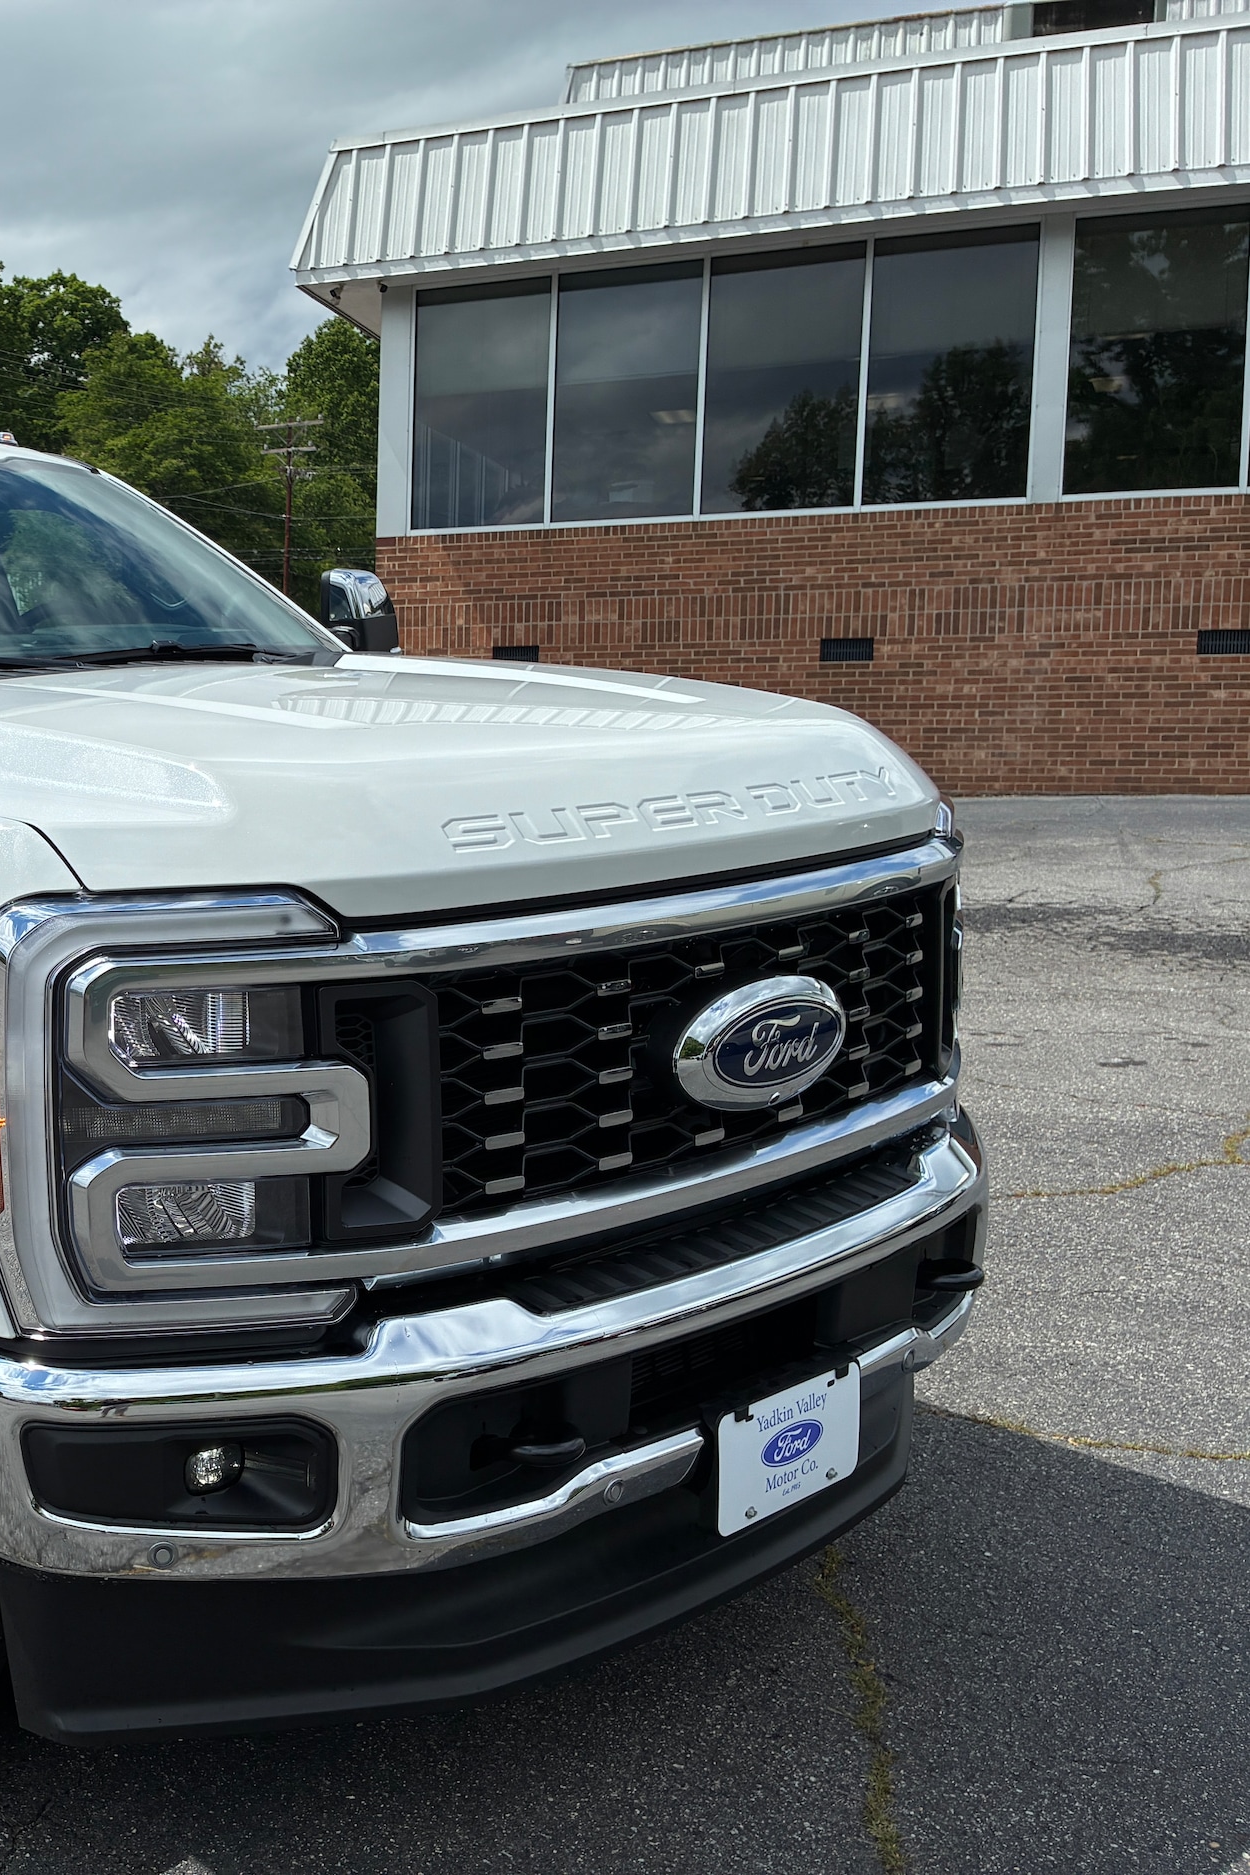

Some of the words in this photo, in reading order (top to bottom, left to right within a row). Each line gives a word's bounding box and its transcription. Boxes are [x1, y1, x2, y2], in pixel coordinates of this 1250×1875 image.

[440, 790, 748, 853] SUPER
[746, 766, 897, 816] DUTY
[743, 1014, 820, 1077] Ford
[756, 1406, 794, 1432] Yadkin
[795, 1392, 827, 1415] Valley
[773, 1427, 812, 1462] Ford
[765, 1468, 799, 1493] Motor
[801, 1458, 819, 1475] Co.
